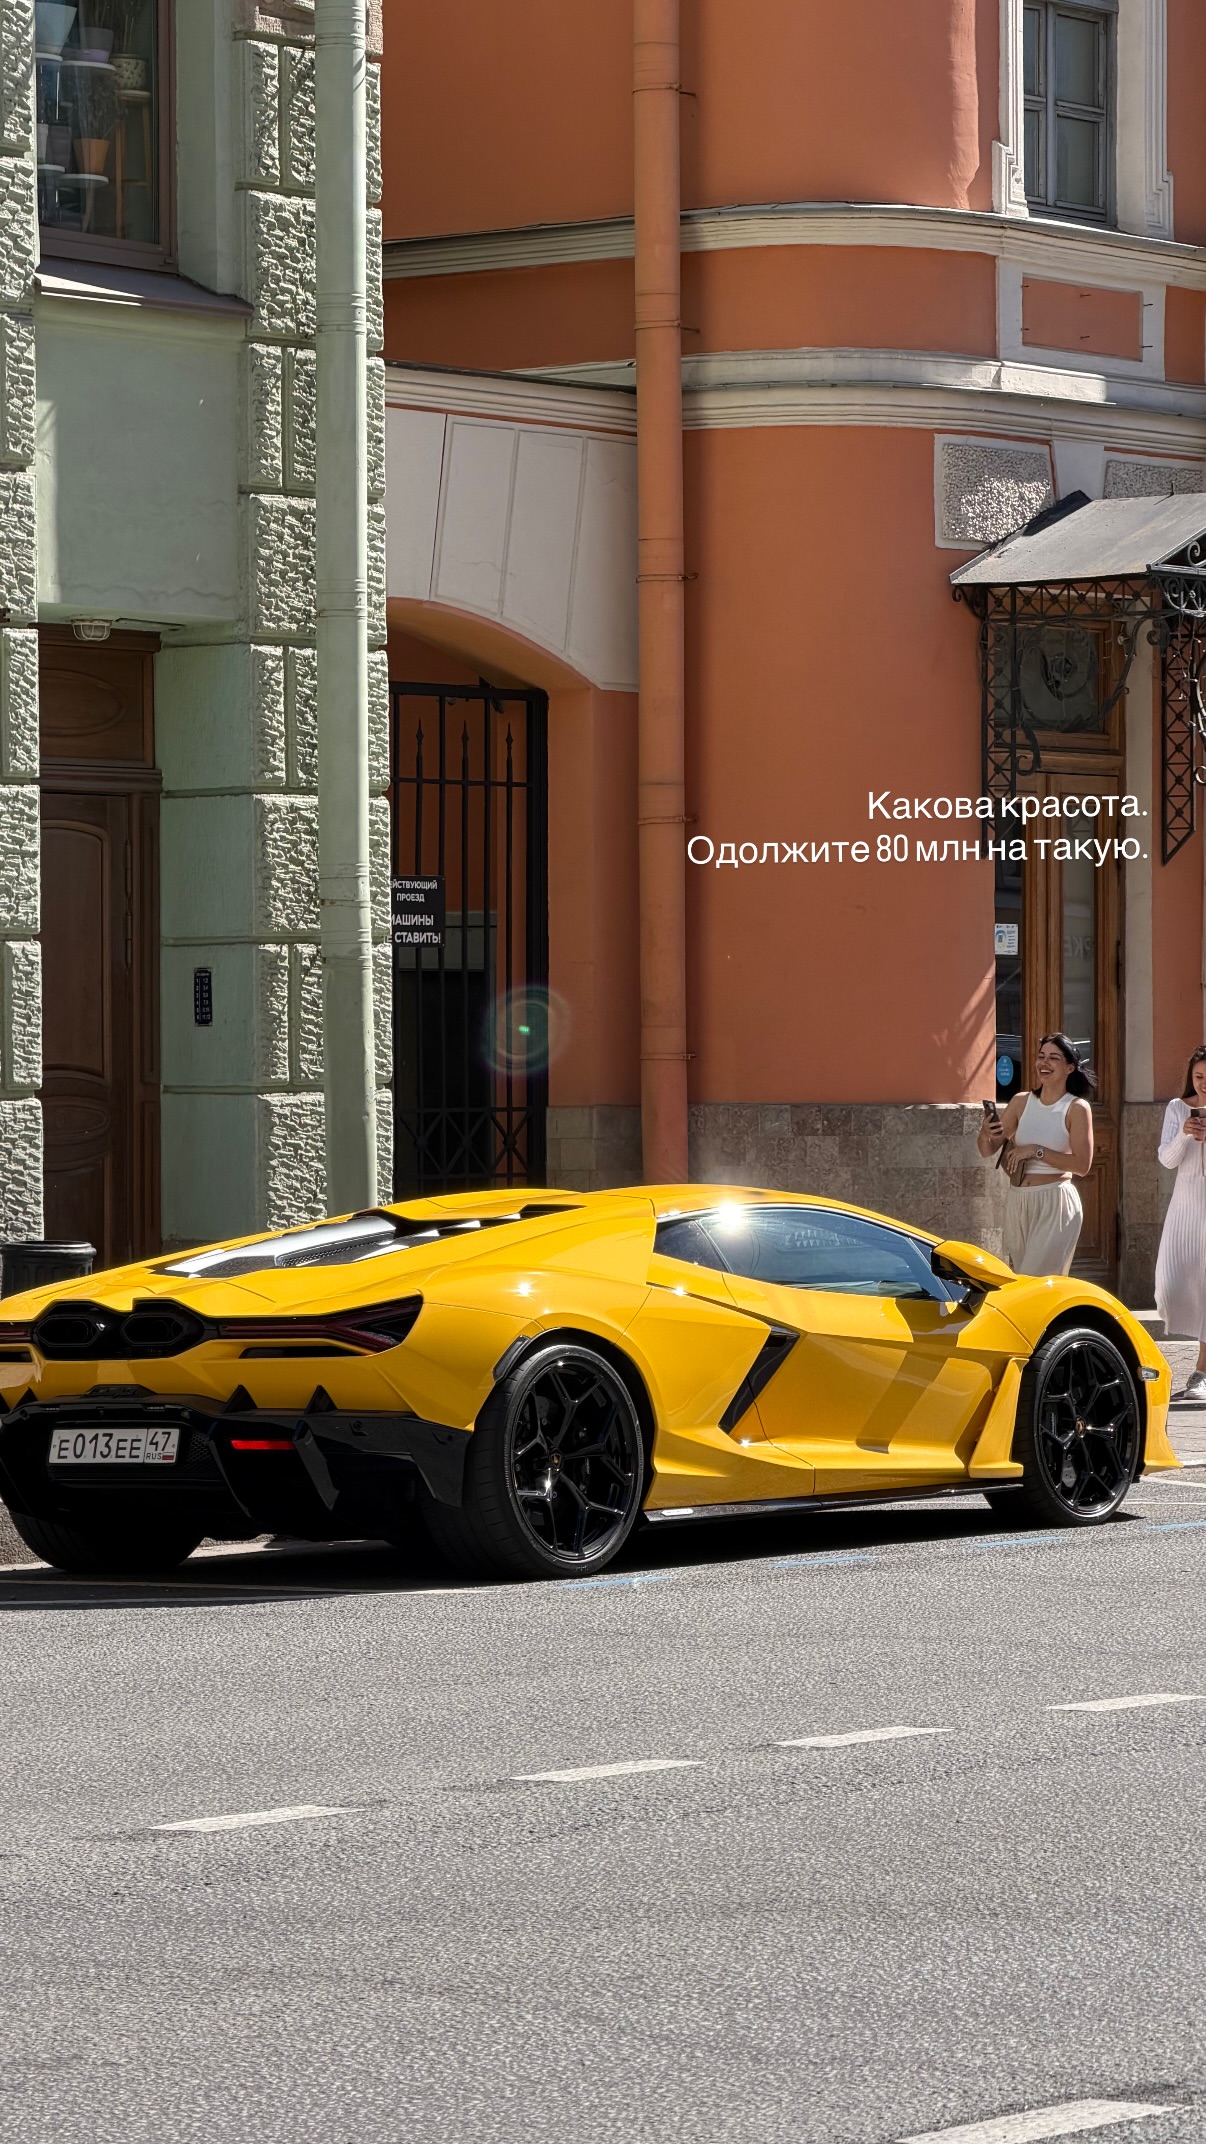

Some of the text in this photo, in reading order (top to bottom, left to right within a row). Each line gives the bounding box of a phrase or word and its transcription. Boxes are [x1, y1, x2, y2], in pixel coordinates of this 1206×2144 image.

[390, 879, 438, 890] ЕЙСТВУЮЩИЙ
[396, 893, 425, 902] ПРОЕЗД
[394, 932, 441, 944] СТАВИТЬ!
[148, 1431, 171, 1452] 47
[145, 1452, 162, 1460] RUS
